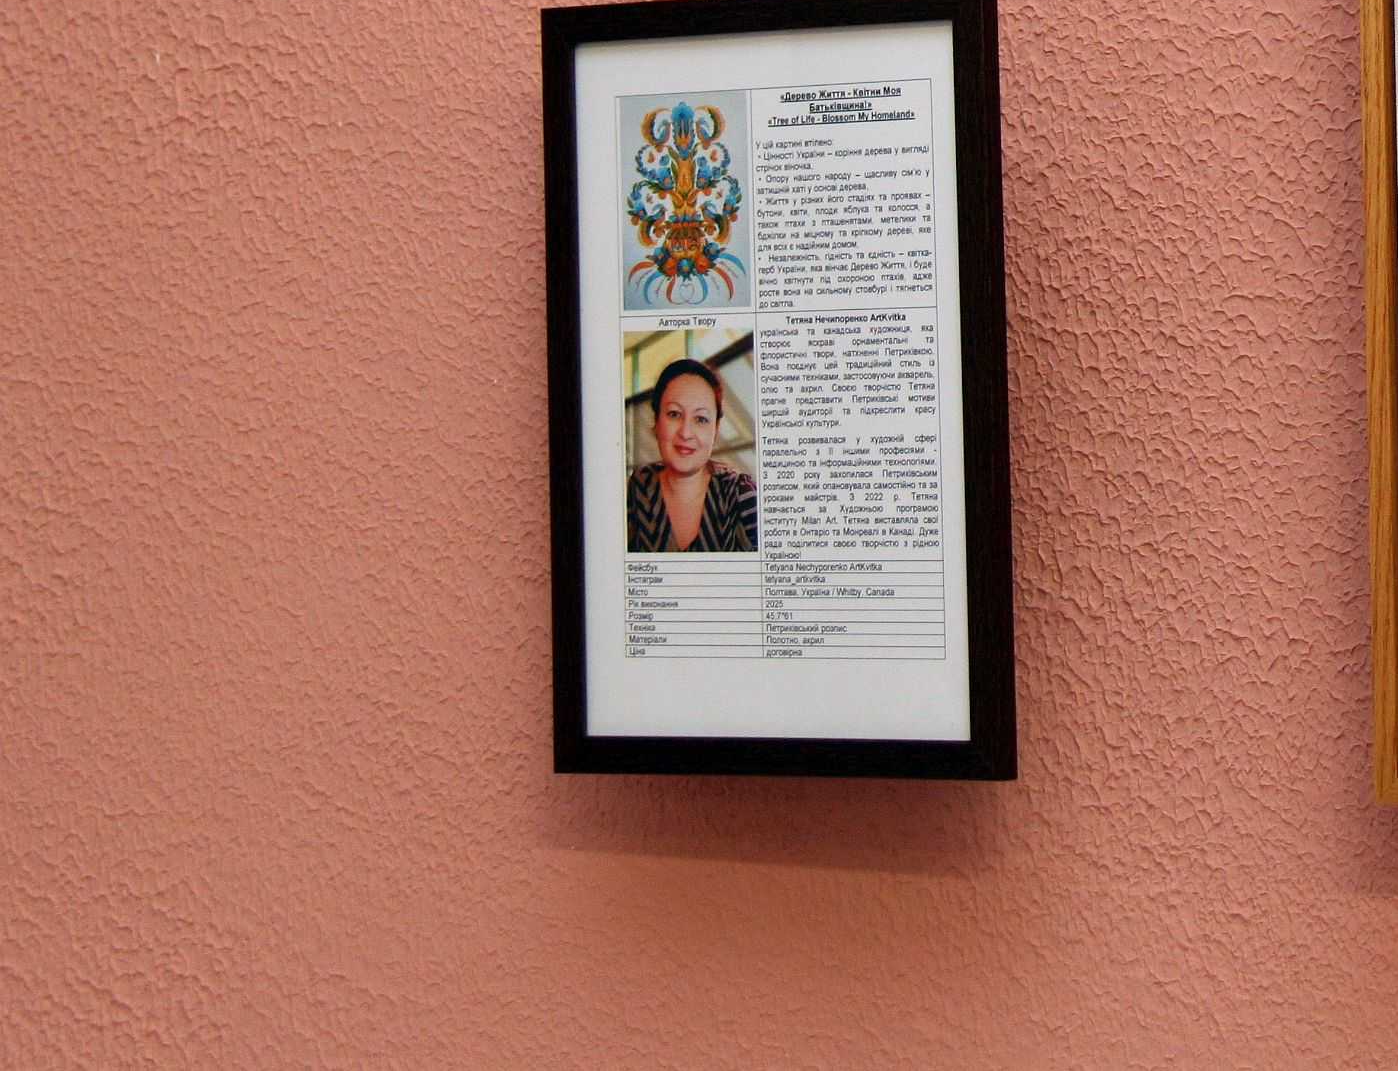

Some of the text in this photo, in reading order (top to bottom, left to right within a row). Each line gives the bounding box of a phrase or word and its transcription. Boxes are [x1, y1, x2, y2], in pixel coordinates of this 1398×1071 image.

[780, 85, 901, 100] «Дерево Життя Квітни Моя
[767, 109, 914, 124] «Tree of Life Blossom My Homeland»
[658, 315, 717, 328] Авторка Твору
[786, 312, 906, 325] Тетяна Нечипоренко ArtKvitka
[908, 381, 935, 390] Тетяна
[761, 435, 788, 445] Тетяна
[776, 470, 795, 479] 2020
[864, 491, 938, 501] 2022 Тетяна
[801, 516, 821, 524] Milan
[842, 515, 869, 524] Тетяна
[764, 562, 882, 572] Tetyana Nechyporenko ArtKvitka
[764, 574, 825, 585] tetyana_artkvitka
[801, 587, 830, 597] Україна
[865, 587, 894, 596] Canada
[765, 600, 783, 608] 2025
[766, 623, 847, 633] Петриківський розпис
[801, 636, 824, 645] акрил
[765, 648, 802, 657] договірна
